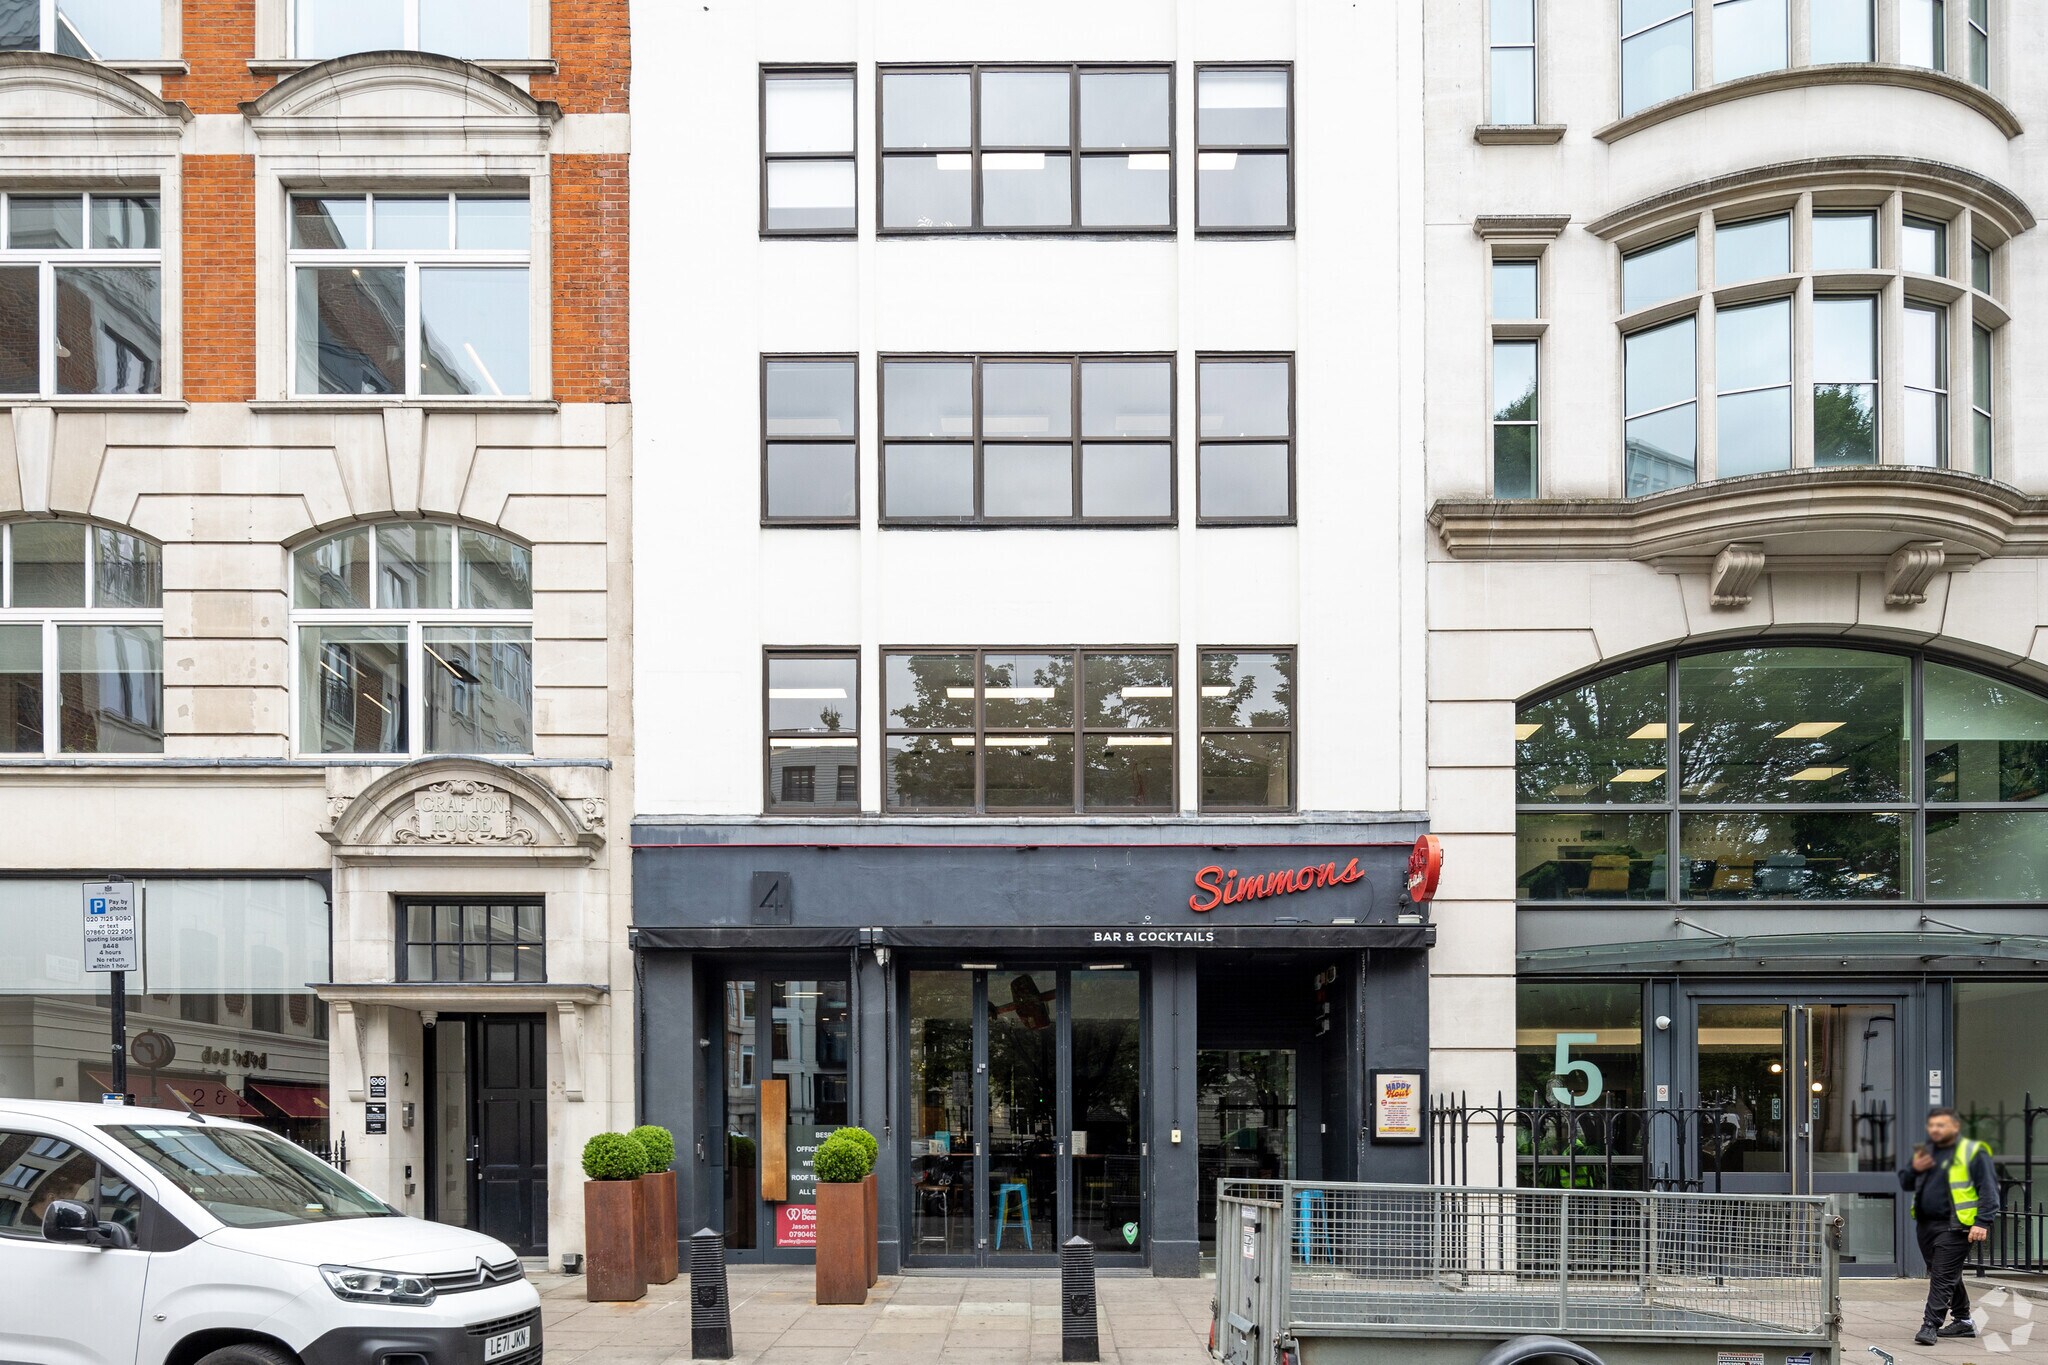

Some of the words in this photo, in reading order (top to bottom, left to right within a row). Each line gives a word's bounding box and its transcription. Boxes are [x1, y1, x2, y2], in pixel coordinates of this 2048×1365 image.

[432, 814, 492, 832] HOUSE
[1189, 857, 1365, 912] Simmons
[759, 880, 783, 915] 4
[1094, 932, 1121, 942] BAR
[1126, 932, 1134, 942] &
[1139, 932, 1214, 942] COCKTAILS
[1552, 1033, 1603, 1107] 5
[1386, 1082, 1411, 1090] HAPPY
[1386, 1089, 1410, 1098] Hour
[193, 1089, 205, 1107] 2
[215, 1089, 227, 1105] &
[490, 1334, 510, 1356] LE71
[511, 1329, 526, 1348] JKN
